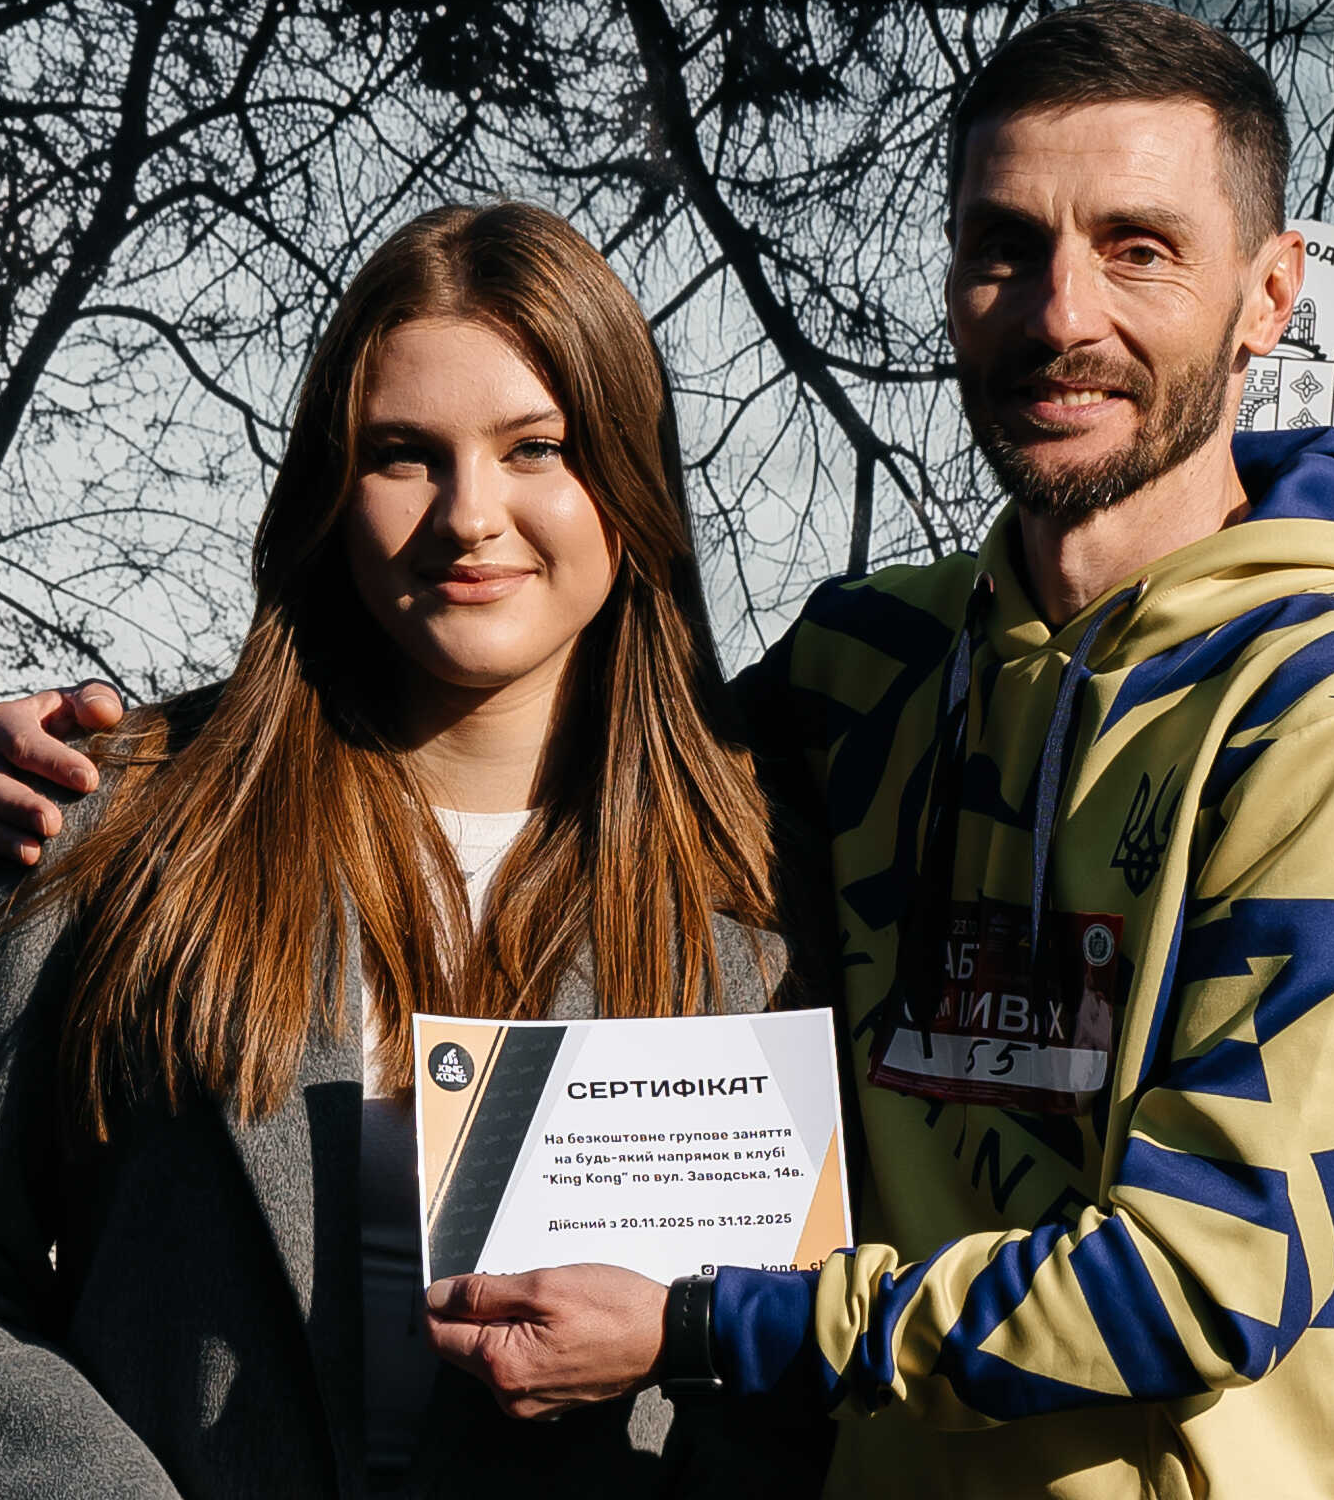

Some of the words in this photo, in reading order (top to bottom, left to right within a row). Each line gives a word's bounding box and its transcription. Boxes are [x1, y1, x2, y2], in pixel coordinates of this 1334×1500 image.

[567, 1076, 768, 1100] СЕРТИФІКАТ
[544, 1133, 564, 1145] На
[568, 1131, 665, 1145] безкоштовне
[669, 1131, 729, 1144] групове
[732, 1128, 792, 1141] заняття
[554, 1155, 573, 1165] на
[576, 1151, 654, 1166] будь-який
[657, 1150, 730, 1165] напрямок
[734, 1150, 742, 1160] в
[746, 1147, 786, 1161] клубі
[632, 1173, 650, 1183] по
[654, 1172, 684, 1185] вул.
[687, 1169, 771, 1182] Заводська,
[548, 1218, 606, 1232] Дійсний
[610, 1220, 617, 1229] з
[620, 1216, 695, 1229] 20.11.2025
[698, 1217, 715, 1228] по
[718, 1213, 793, 1226] 31.12.2025
